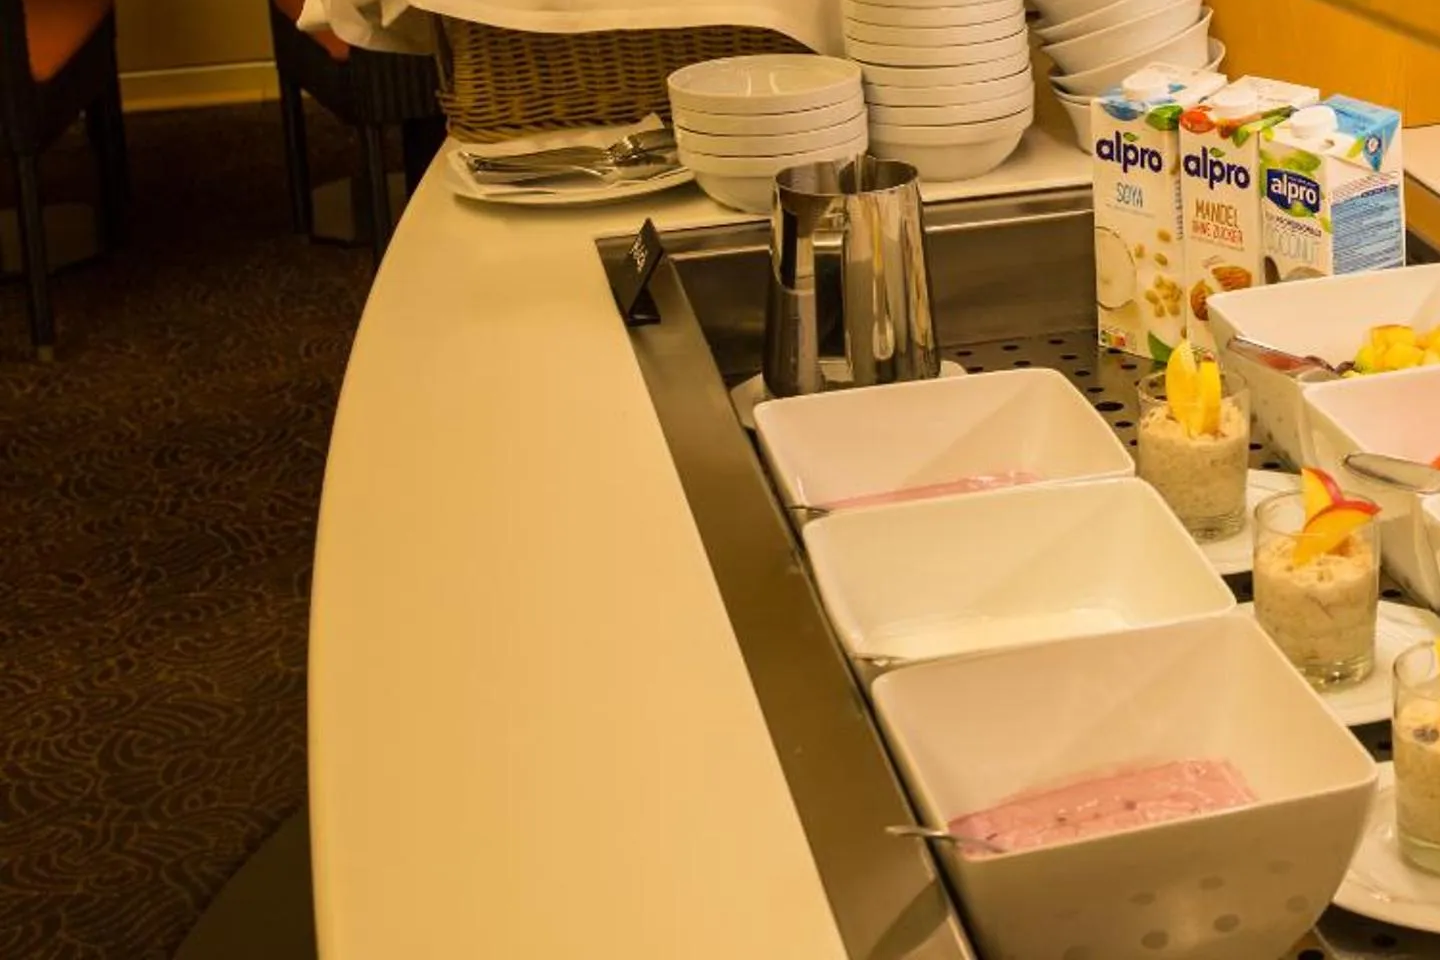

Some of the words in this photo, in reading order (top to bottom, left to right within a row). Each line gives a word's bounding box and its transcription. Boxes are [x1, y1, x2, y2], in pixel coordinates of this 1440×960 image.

[1096, 130, 1162, 173] alpro
[1183, 145, 1250, 190] alpro
[1116, 182, 1144, 208] SOYA
[1270, 173, 1317, 205] alpro
[1195, 198, 1240, 229] MANDEL
